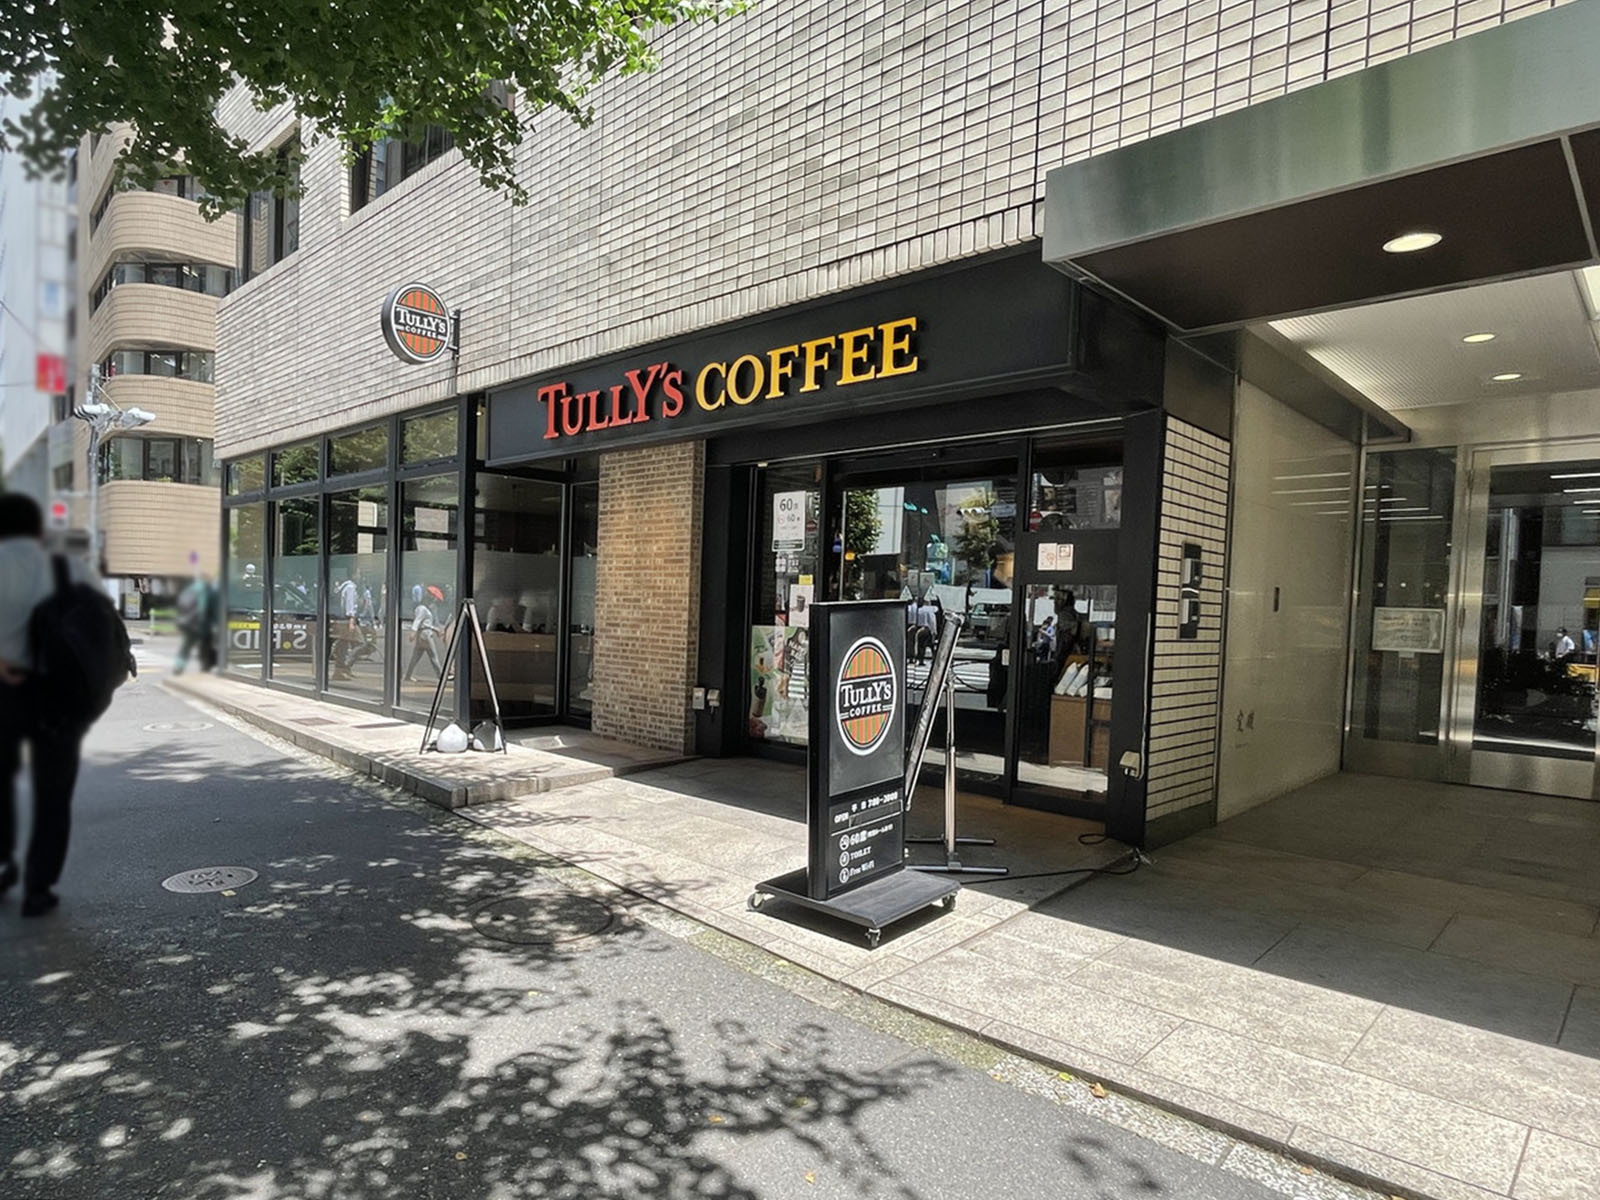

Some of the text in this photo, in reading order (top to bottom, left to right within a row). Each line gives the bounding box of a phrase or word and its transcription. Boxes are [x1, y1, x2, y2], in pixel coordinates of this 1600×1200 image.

[396, 308, 446, 333] TULLY'S
[405, 325, 437, 338] COFFEE
[537, 316, 919, 440] TULLY'S COFFEE
[841, 681, 892, 708] TULLY'S
[849, 703, 883, 718] COFFEE
[850, 846, 872, 861] TOILET
